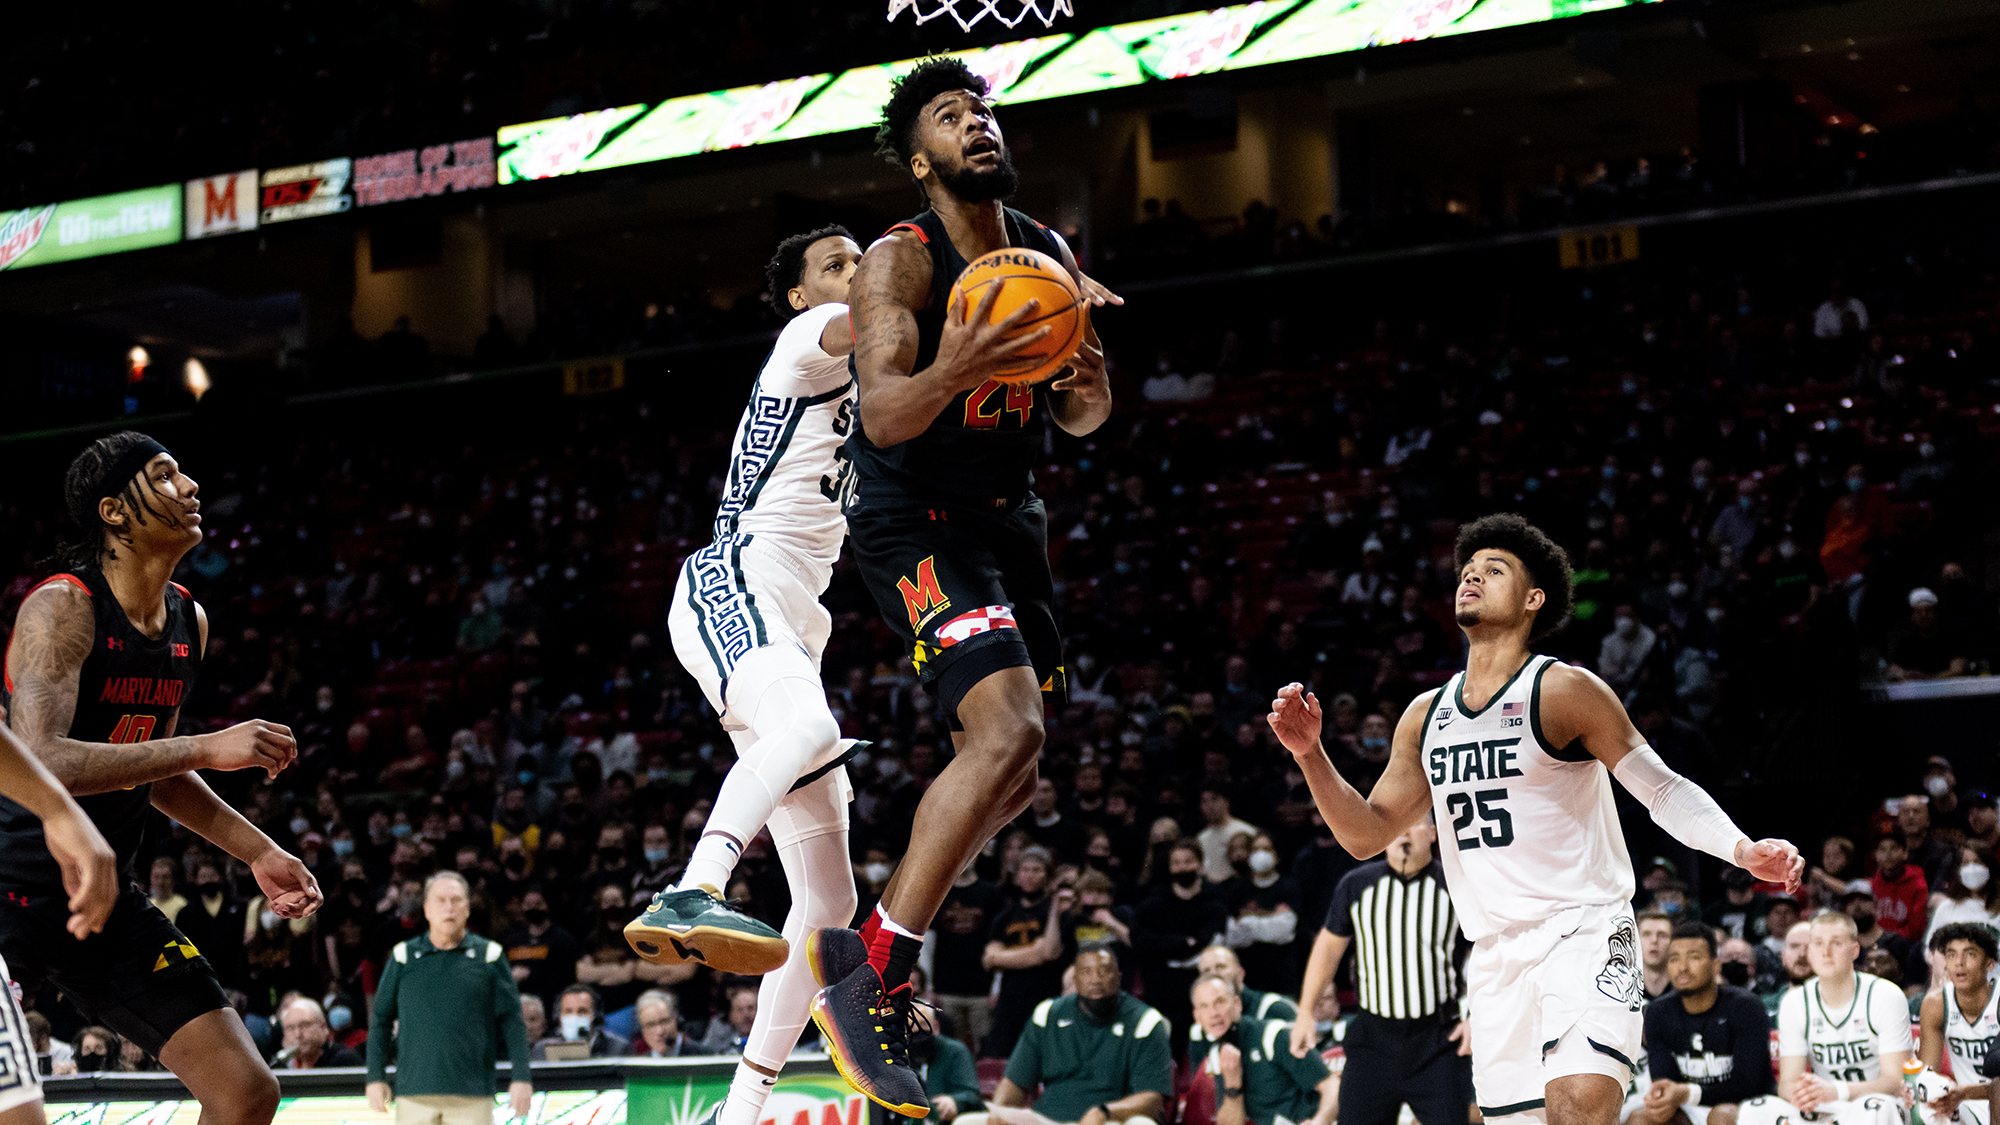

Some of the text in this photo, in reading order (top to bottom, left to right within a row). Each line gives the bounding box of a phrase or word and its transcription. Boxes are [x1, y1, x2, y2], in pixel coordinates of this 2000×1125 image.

[59, 214, 91, 247] DO
[119, 200, 172, 238] DEW
[204, 173, 238, 228] M
[1577, 234, 1622, 263] 101
[896, 554, 949, 630] M
[98, 677, 184, 706] MARYLAND
[1430, 737, 1524, 787] STATE
[1446, 788, 1515, 851] 25
[1811, 1038, 1875, 1065] STATE
[1948, 1035, 2000, 1060] STA
